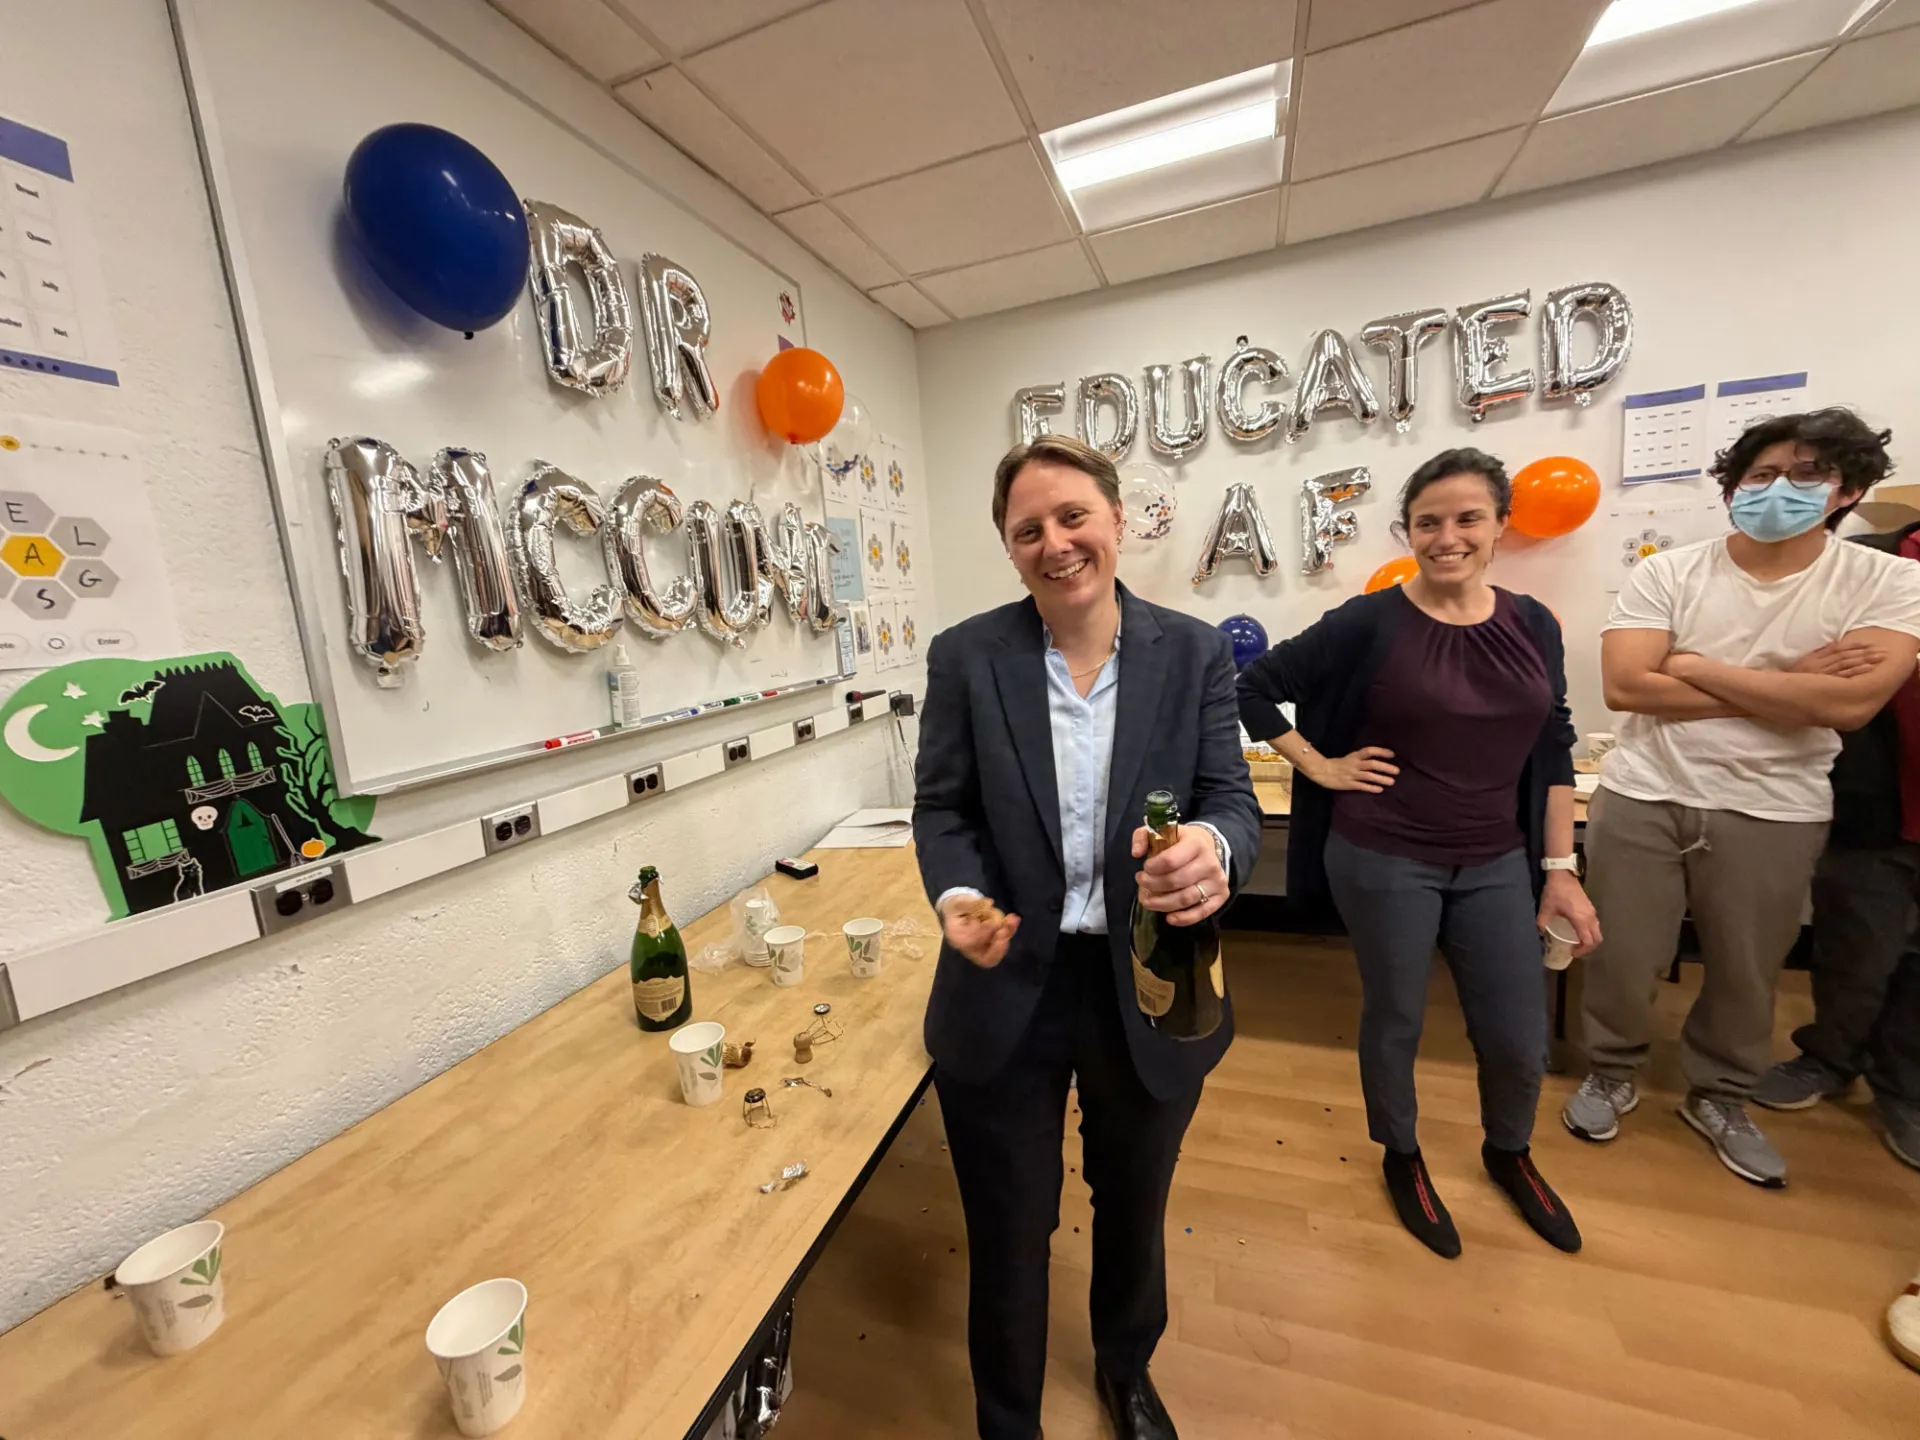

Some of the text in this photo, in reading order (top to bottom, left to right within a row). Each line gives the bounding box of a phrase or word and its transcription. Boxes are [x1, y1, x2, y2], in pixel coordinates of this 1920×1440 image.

[523, 198, 719, 421] DR
[1013, 281, 1633, 460] EDUCATED
[6, 501, 29, 523] E
[73, 526, 97, 546] L
[1193, 466, 1371, 584] AF
[24, 542, 45, 566] A
[78, 569, 103, 588] G
[36, 588, 56, 609] S
